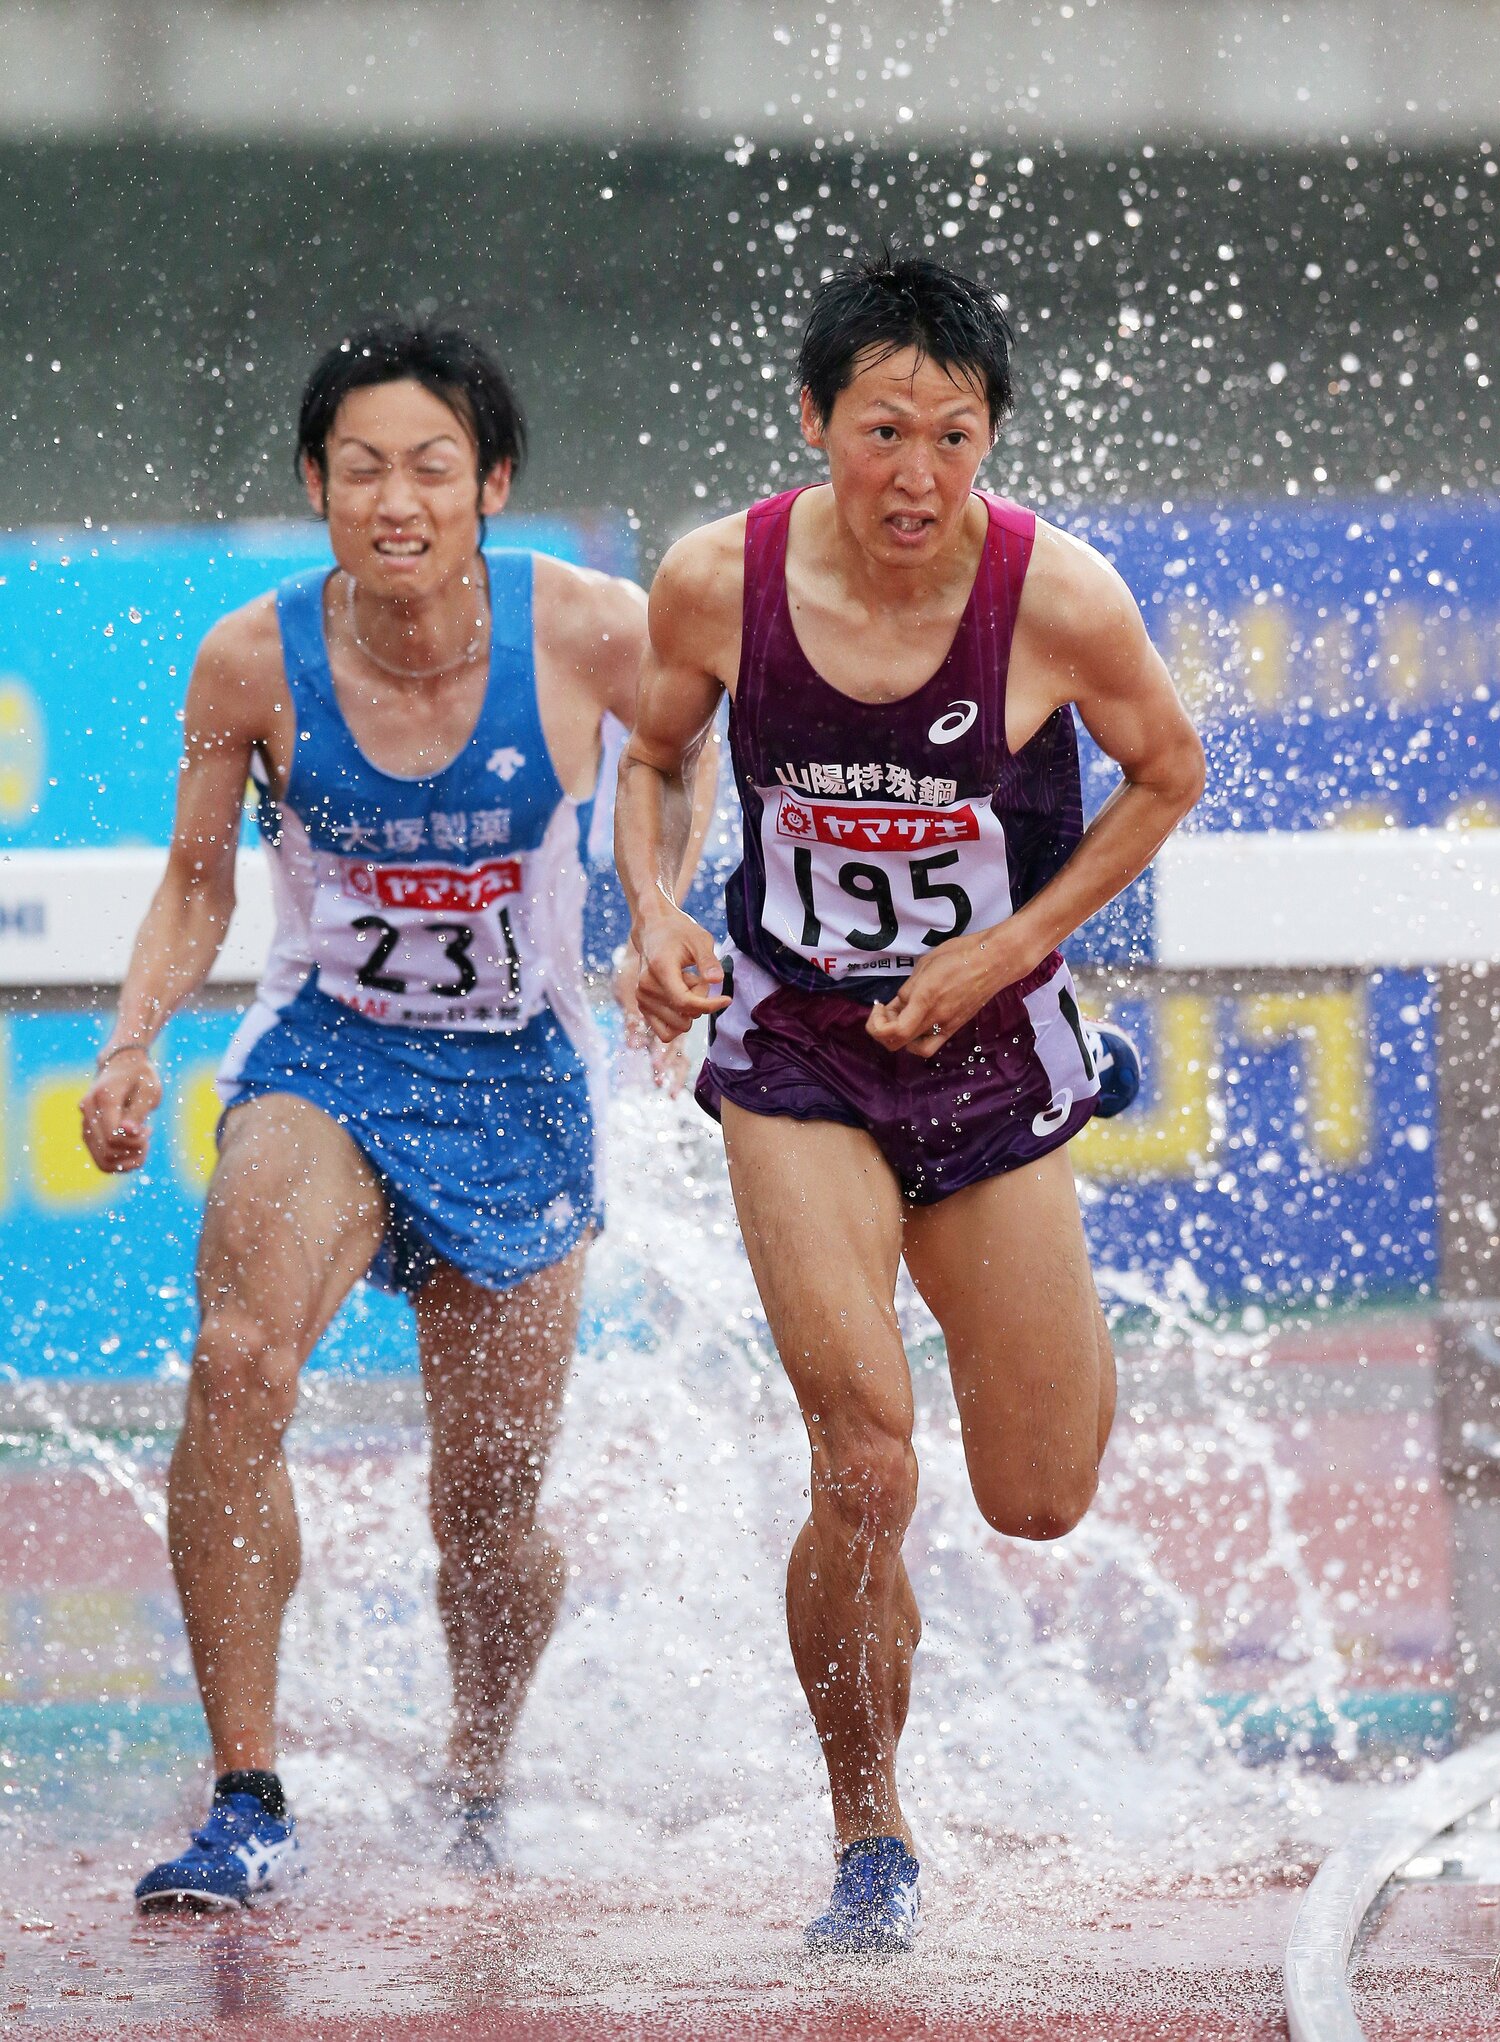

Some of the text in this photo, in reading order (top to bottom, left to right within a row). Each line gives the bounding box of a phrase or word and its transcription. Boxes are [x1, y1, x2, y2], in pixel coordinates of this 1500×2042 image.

[775, 763, 958, 807] 山陽特殊鋼
[335, 808, 512, 853] 大塚製薬
[823, 815, 968, 844] ヤマザキ
[793, 846, 973, 952] 195
[351, 907, 521, 998] 231
